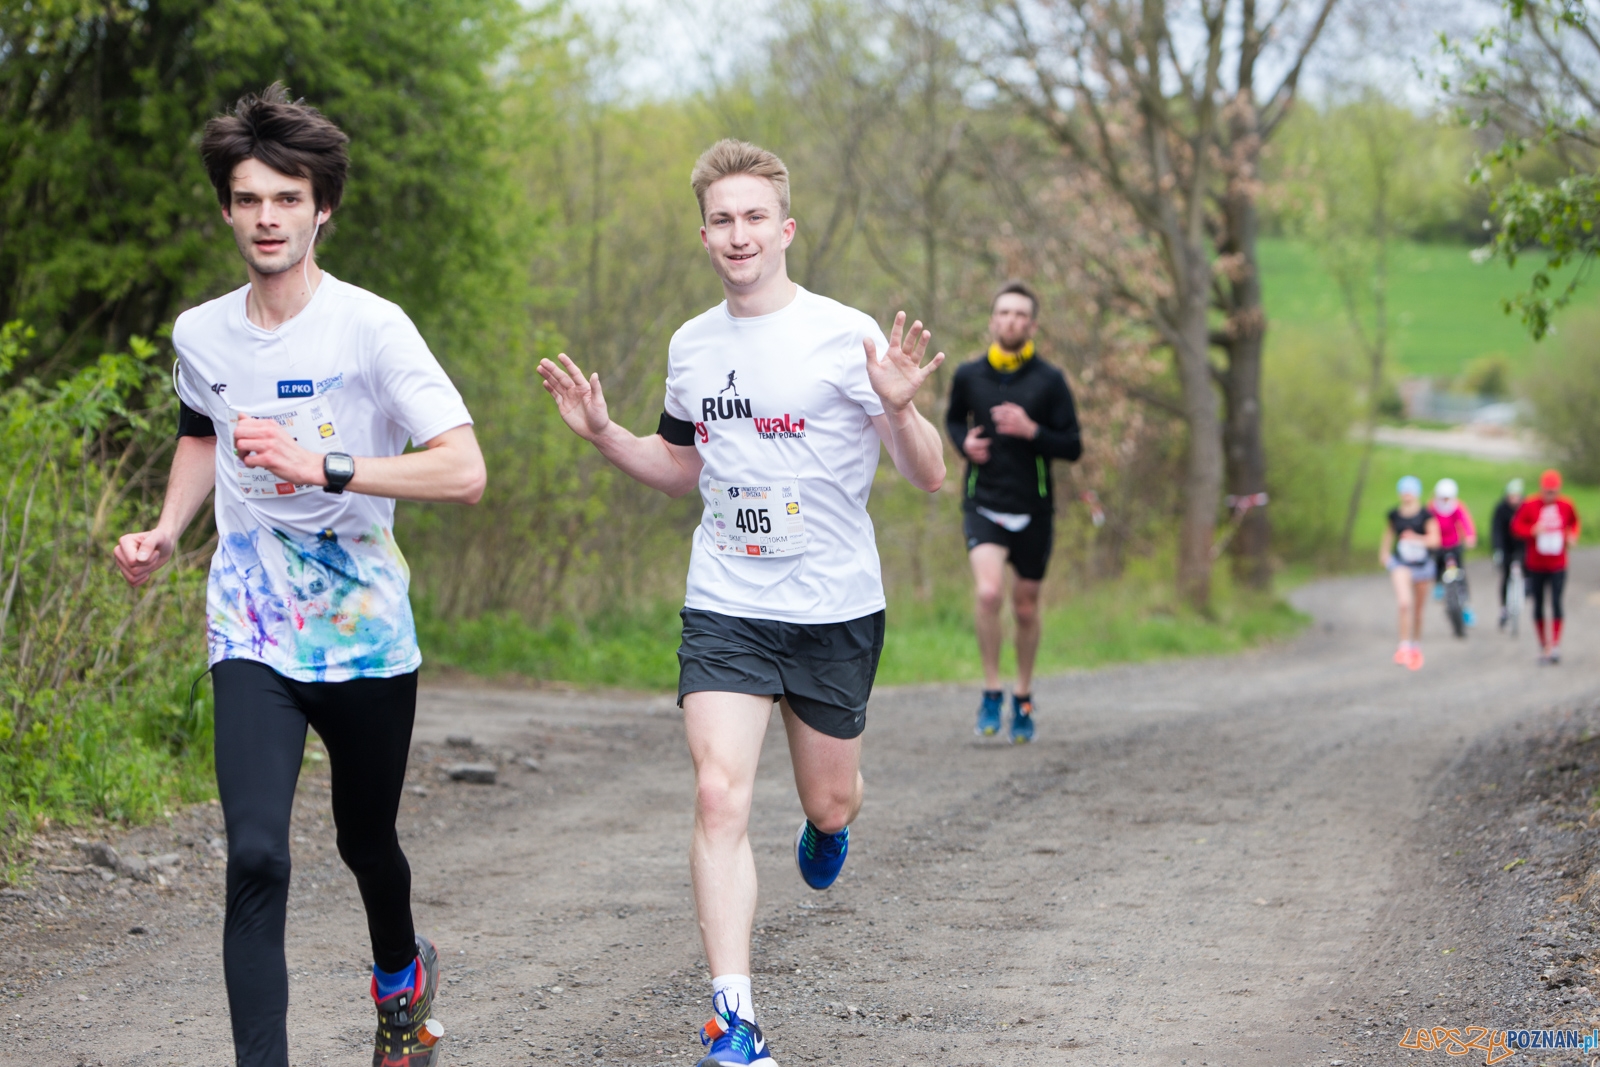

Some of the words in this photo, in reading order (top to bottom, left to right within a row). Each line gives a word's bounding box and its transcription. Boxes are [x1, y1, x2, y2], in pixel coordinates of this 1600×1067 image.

[702, 396, 753, 422] RUN
[758, 432, 776, 440] TEAM
[736, 508, 772, 534] 405
[768, 536, 788, 544] 10KM
